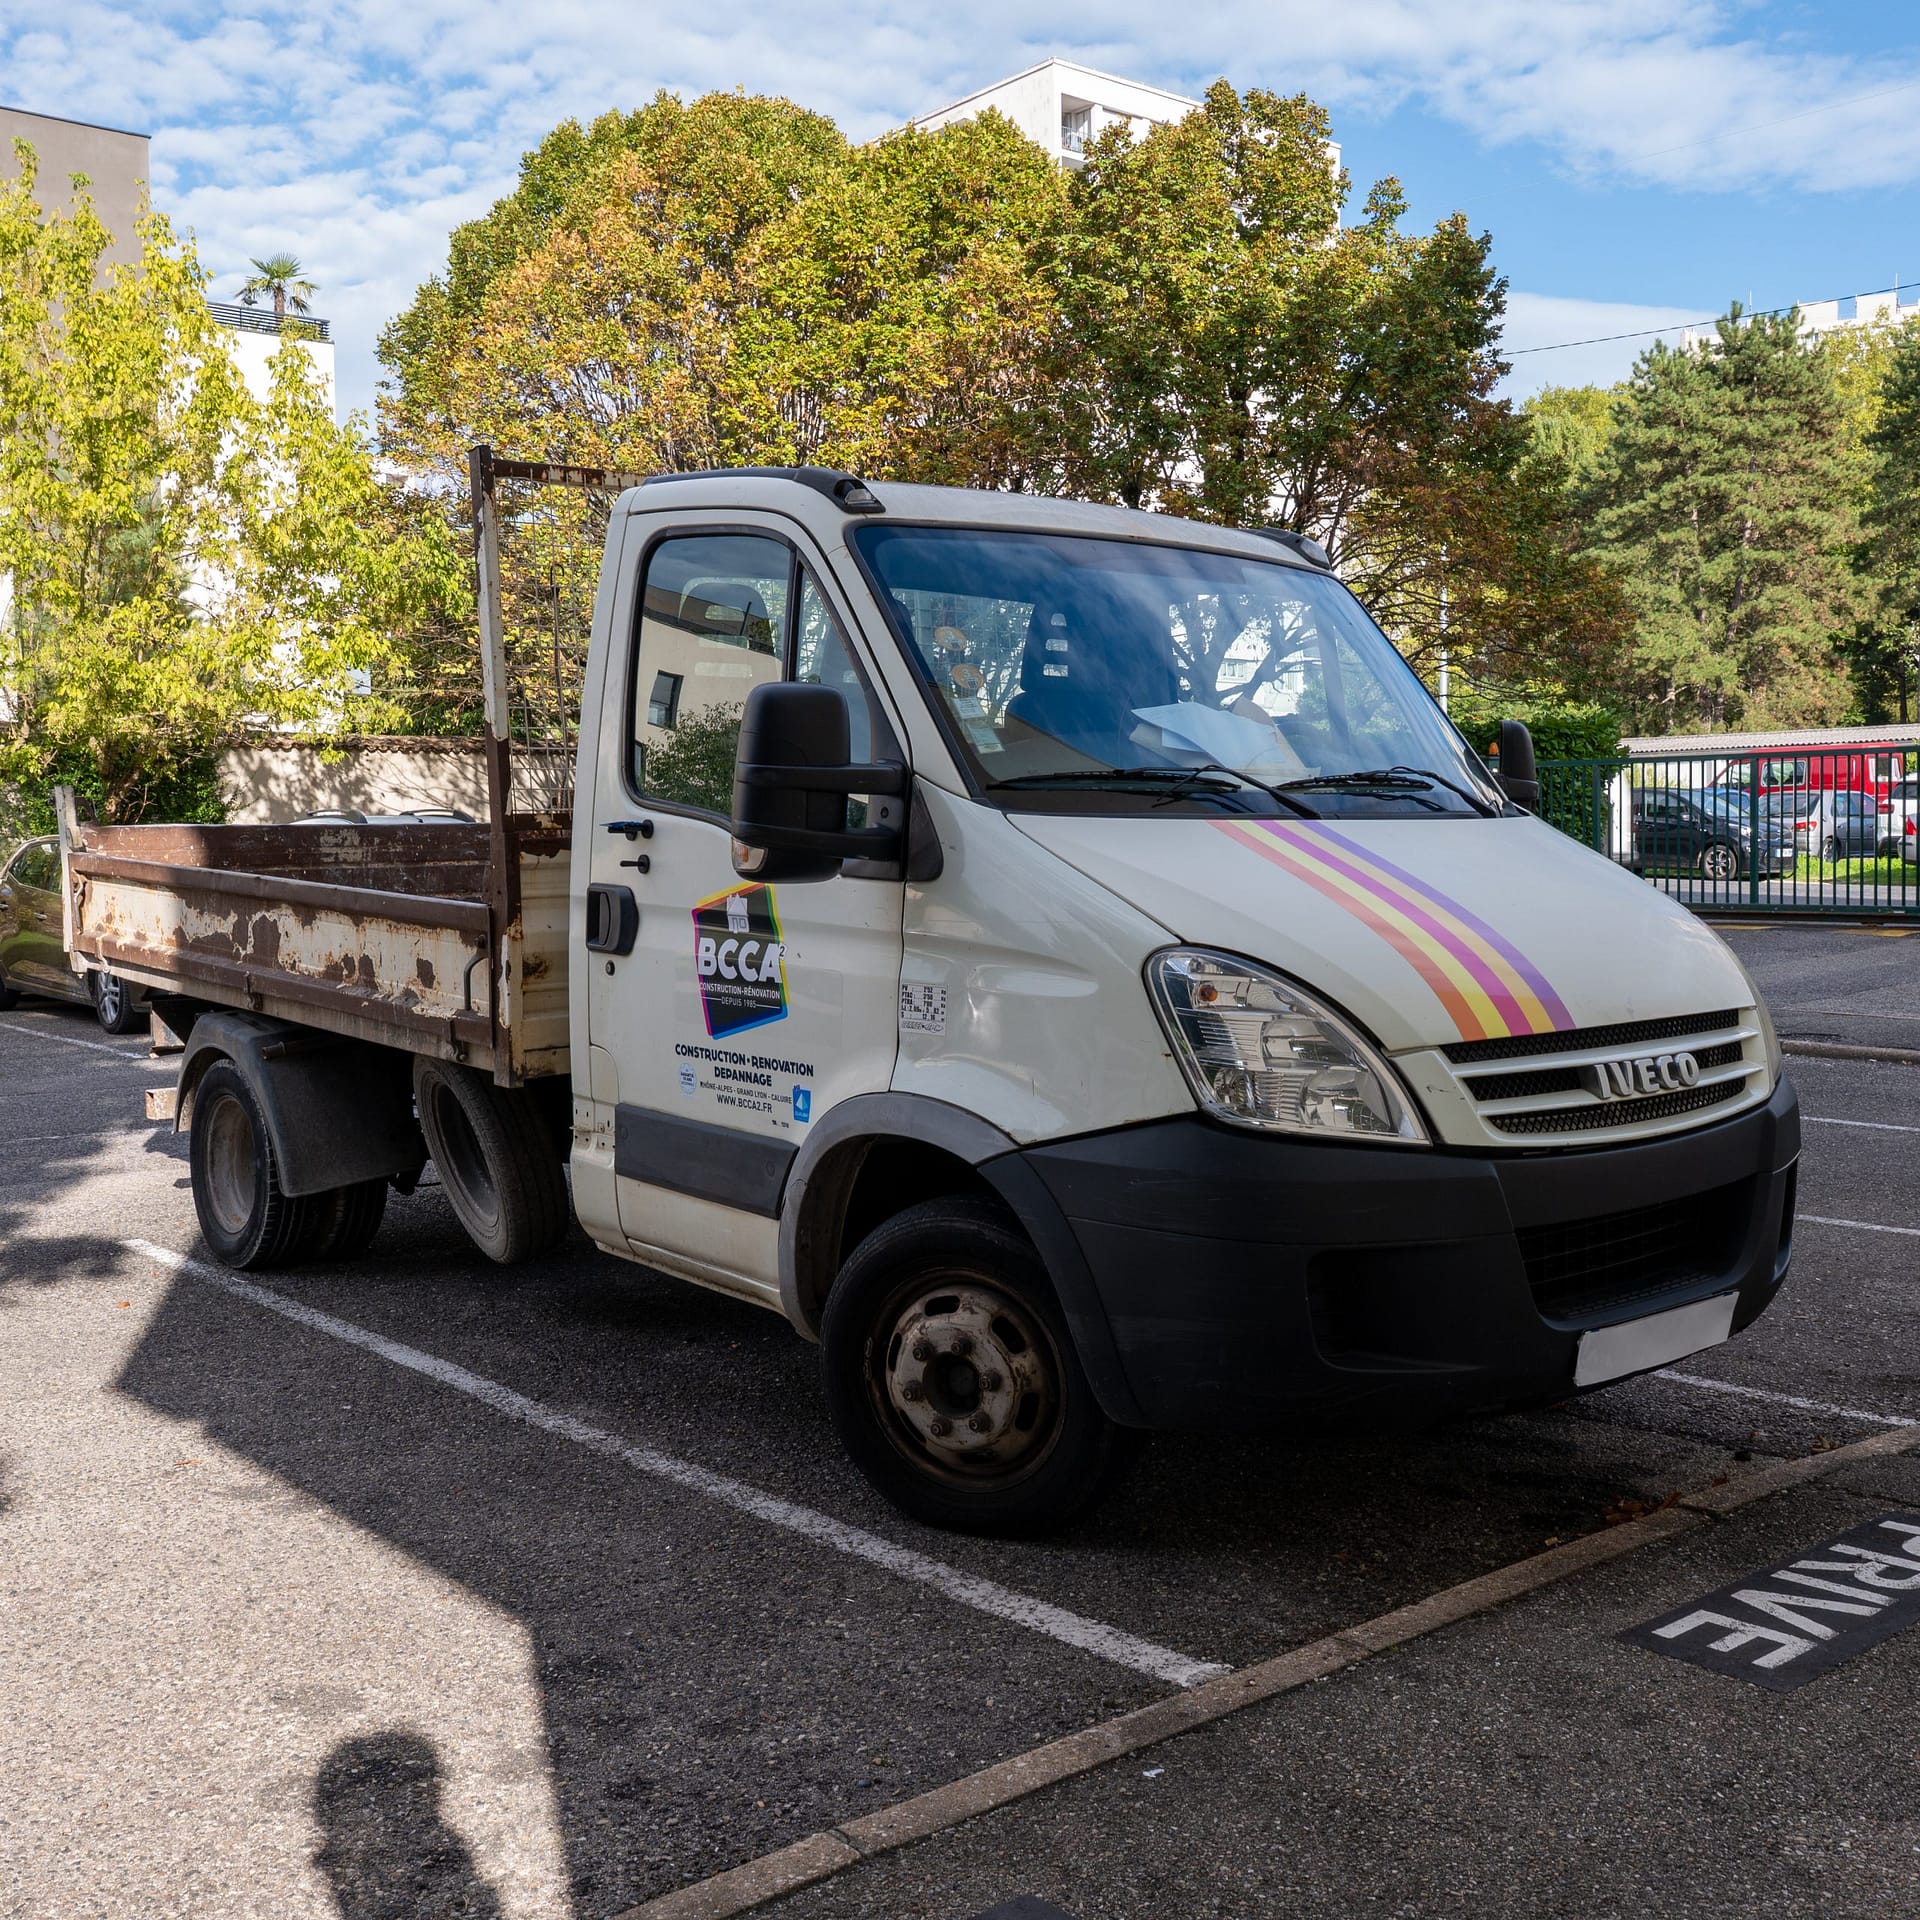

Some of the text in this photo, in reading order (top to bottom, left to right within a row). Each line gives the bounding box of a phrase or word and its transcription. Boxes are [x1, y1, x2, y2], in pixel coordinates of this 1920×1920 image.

[721, 996, 742, 1007] DEPUIS
[714, 1066, 772, 1087] DEPANNAGE
[1594, 1052, 1700, 1099] IVECO
[716, 1093, 773, 1114] WWW.BCCA2.FR
[736, 1087, 753, 1098] GRAND
[754, 1090, 768, 1100] LYON
